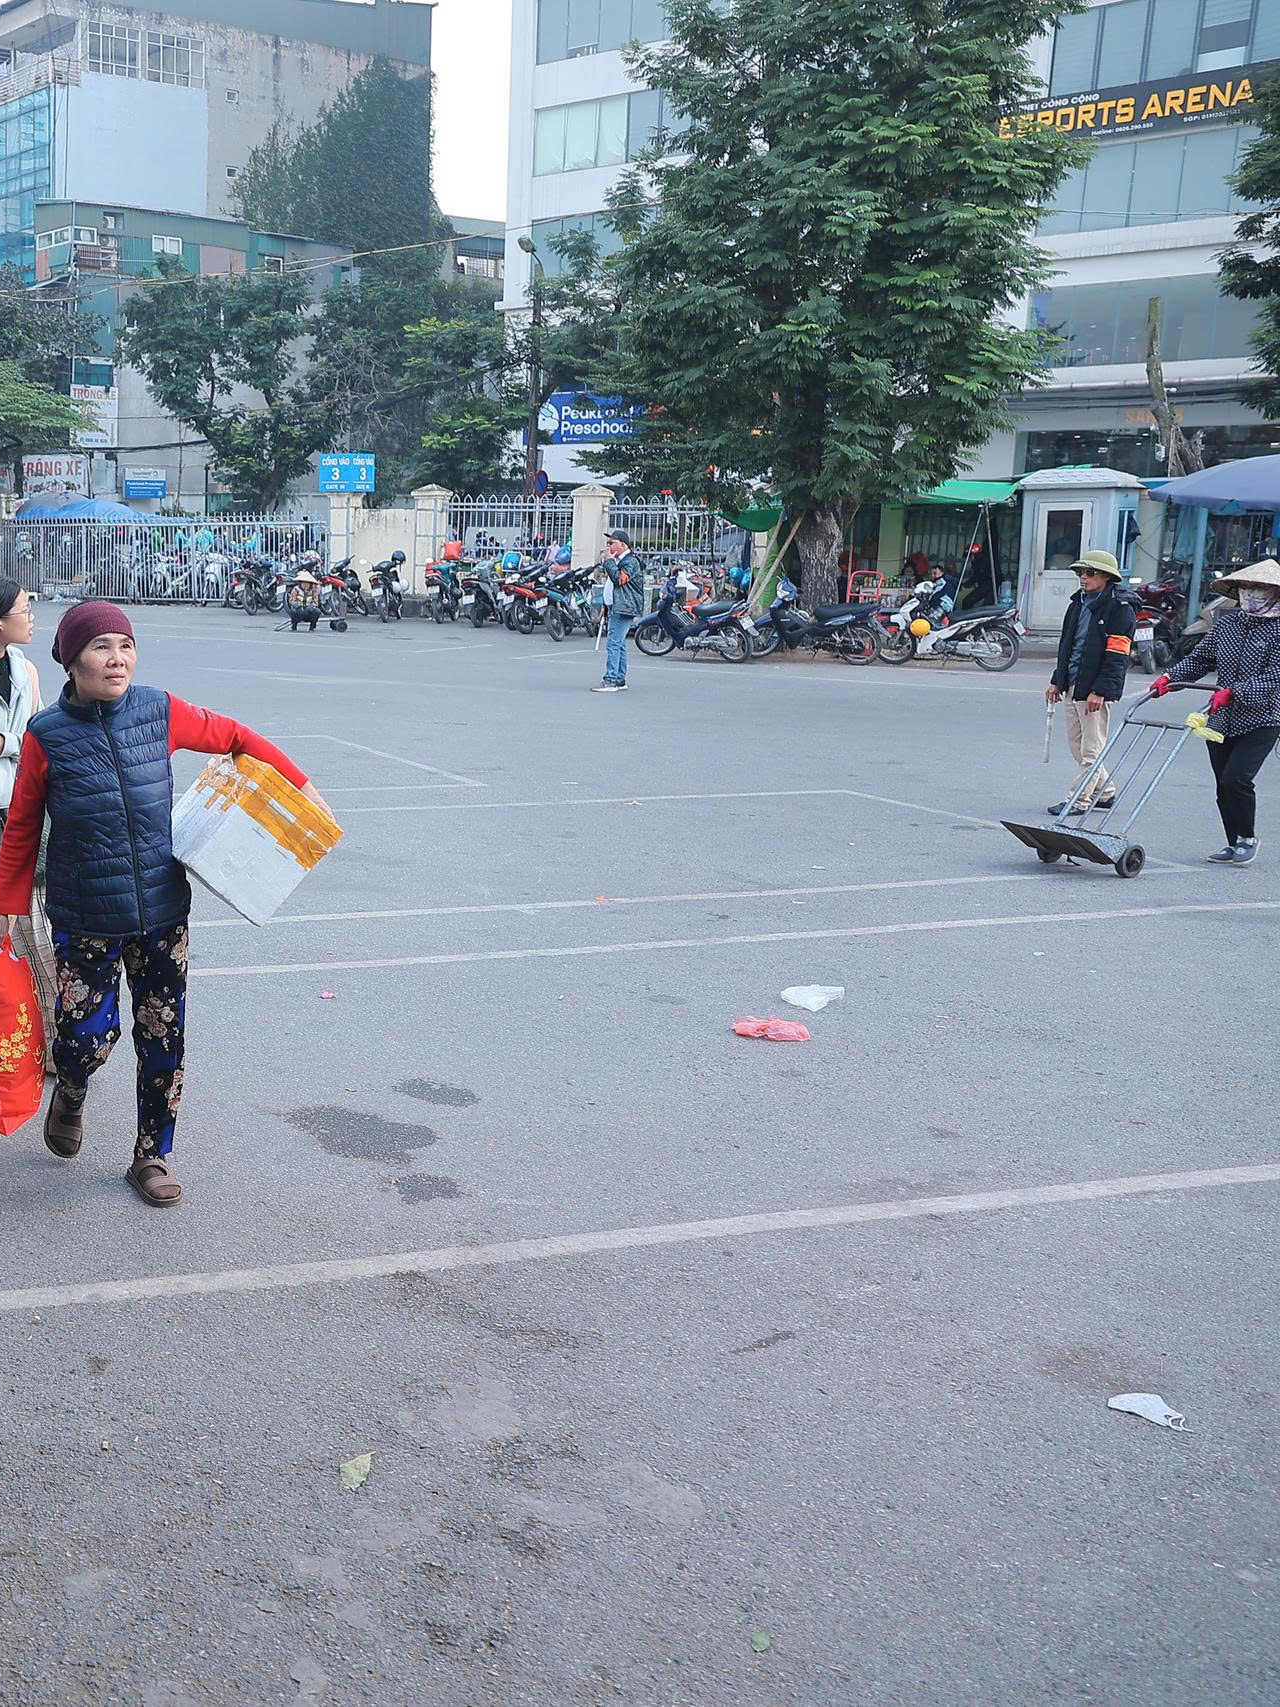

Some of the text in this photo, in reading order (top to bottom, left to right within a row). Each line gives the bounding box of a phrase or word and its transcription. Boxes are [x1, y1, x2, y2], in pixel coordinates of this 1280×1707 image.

[1071, 93, 1100, 105] CỘNG
[1141, 78, 1255, 121] ARENA
[66, 460, 81, 476] XE
[331, 467, 340, 481] 3
[360, 467, 367, 481] 3
